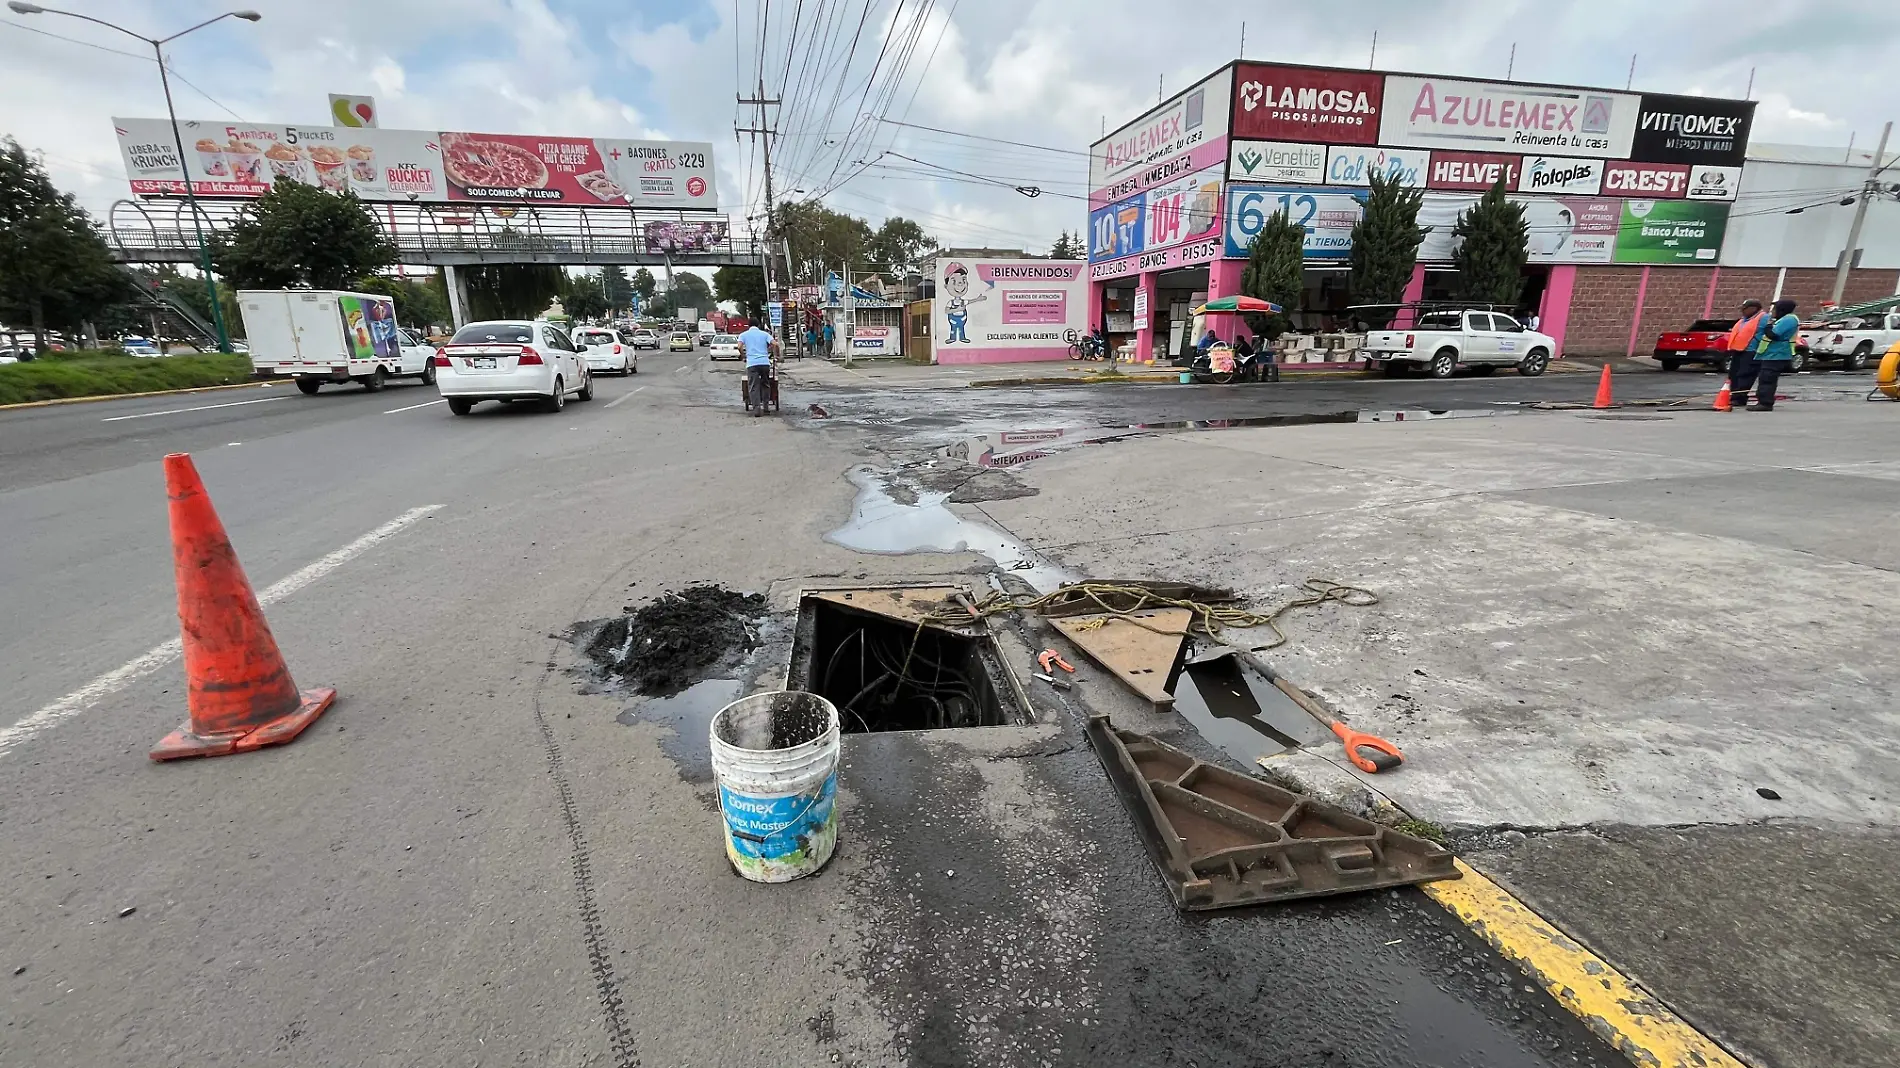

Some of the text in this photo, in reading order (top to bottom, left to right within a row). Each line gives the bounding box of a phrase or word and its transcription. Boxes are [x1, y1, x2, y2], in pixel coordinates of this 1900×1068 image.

[1272, 111, 1363, 125] PISOS & MUROS
[239, 130, 278, 141] ARTISTAS
[286, 128, 298, 145] 5
[298, 131, 335, 141] BUCKETS
[1513, 131, 1609, 149] Reinventa tu casa
[128, 143, 161, 155] LIBERA
[538, 143, 590, 156] PIZZA GRANDE
[131, 154, 179, 168] KRUNCH
[544, 154, 587, 165] HUT CHEESE
[628, 147, 705, 169] BASTONES $229
[1265, 148, 1320, 167] Venettia
[644, 158, 676, 172] GRATIS
[388, 169, 431, 183] BUCKET
[1107, 178, 1138, 200] ENTREGA
[1141, 155, 1192, 187] INMEDIATA
[1434, 161, 1514, 184] HELVEX
[1532, 164, 1592, 188] Rotoplas
[212, 182, 265, 193] kfc.com.mx
[390, 182, 434, 192] CELEBRATION
[1606, 169, 1685, 192] CREST
[468, 188, 487, 197] SOLO
[534, 190, 561, 199] LLEVAR
[1238, 193, 1264, 235] 6
[1321, 211, 1344, 219] MESES
[1641, 226, 1705, 238] Banco Azteca
[1315, 237, 1352, 247] TIENDA
[1092, 261, 1127, 278] AZULEJOS
[1182, 242, 1216, 260] PISOS
[991, 267, 1073, 278] ¡BIENVENIDOS!
[986, 333, 1017, 341] EXCLUSIVO
[1033, 332, 1059, 340] CLIENTES
[729, 795, 778, 814] Comex
[750, 820, 791, 831] Master
